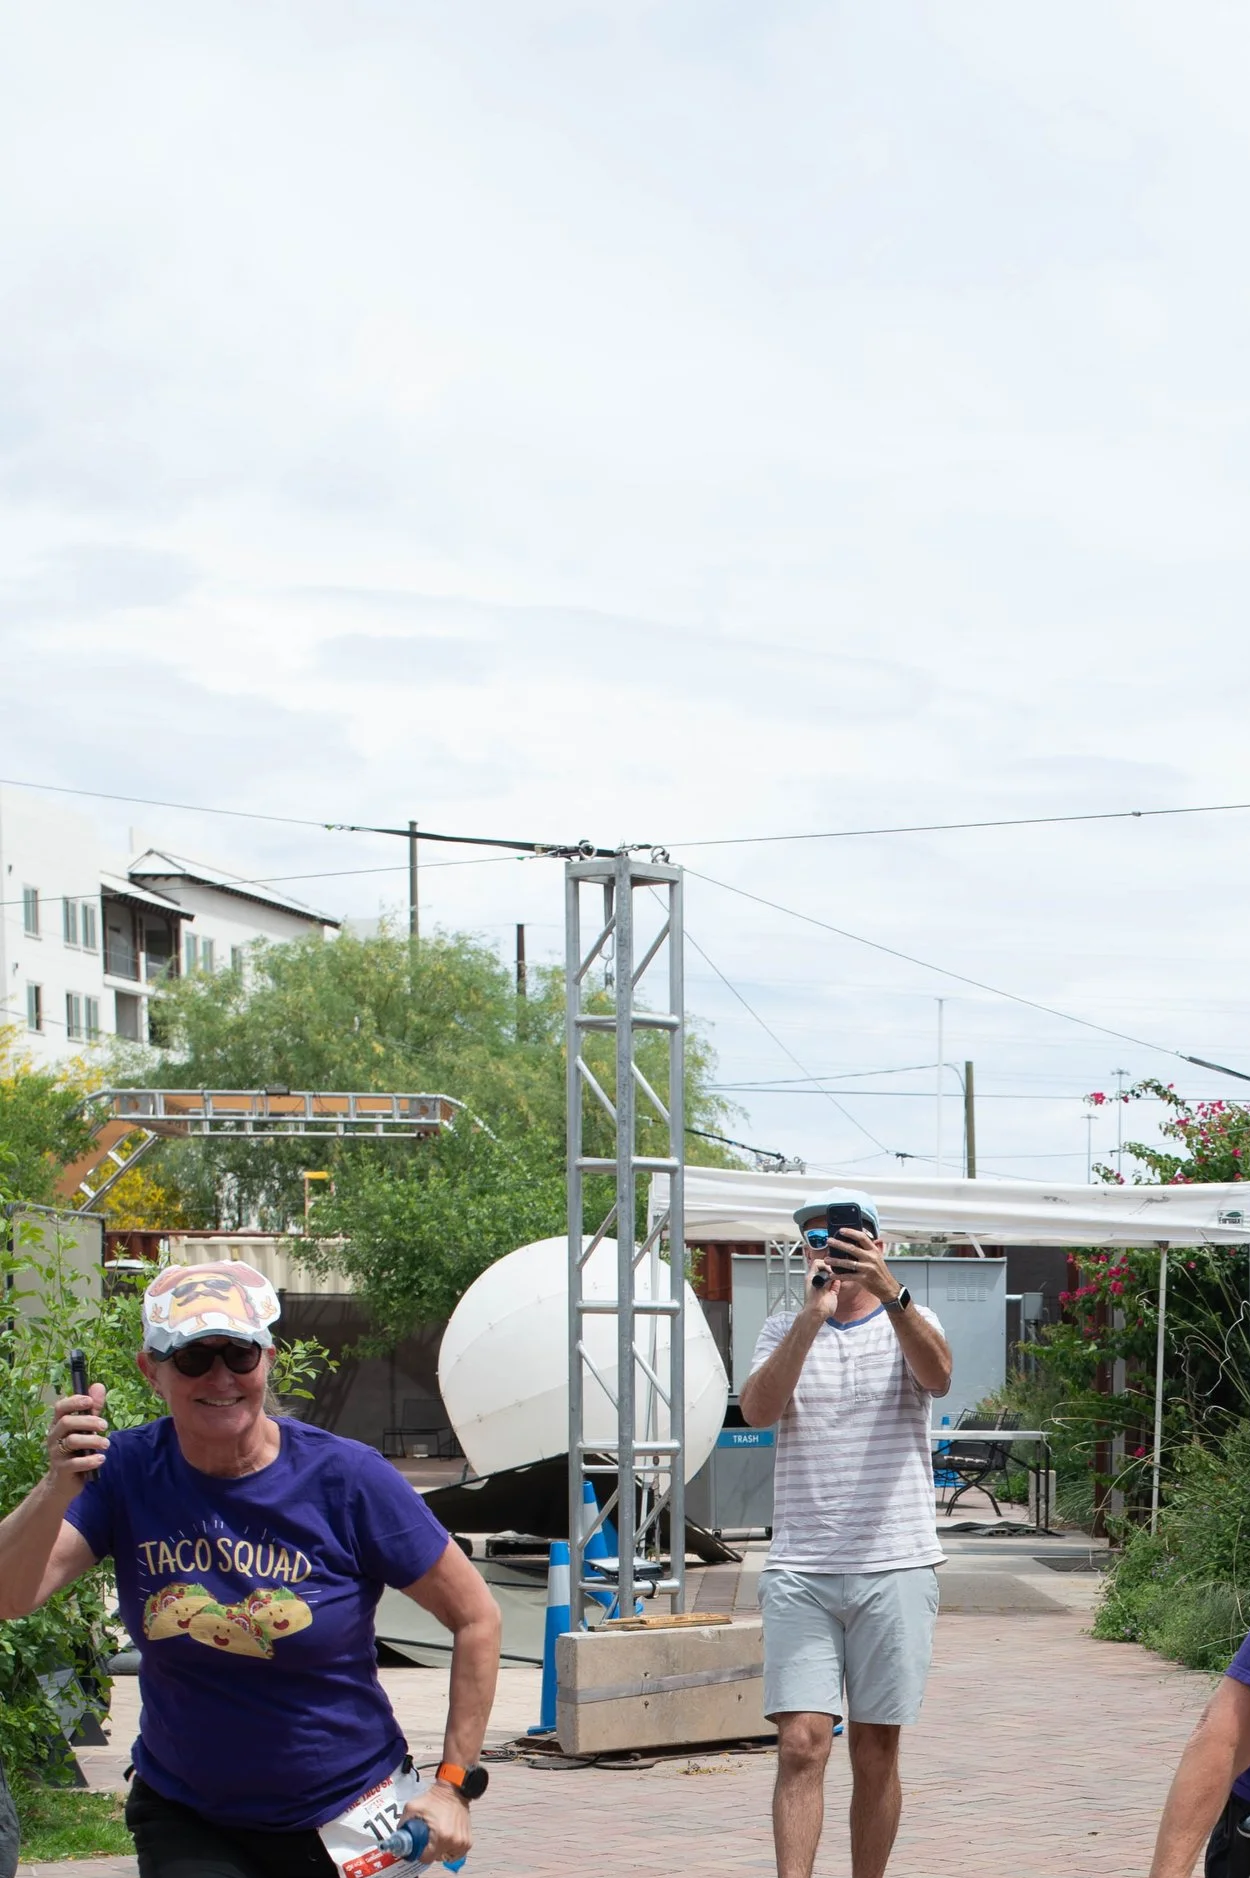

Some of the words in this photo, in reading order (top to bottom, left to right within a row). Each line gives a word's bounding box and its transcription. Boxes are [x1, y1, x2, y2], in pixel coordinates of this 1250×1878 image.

[732, 1434, 759, 1443] TRASH
[138, 1538, 212, 1576] TACO
[216, 1537, 312, 1583] SQUAD
